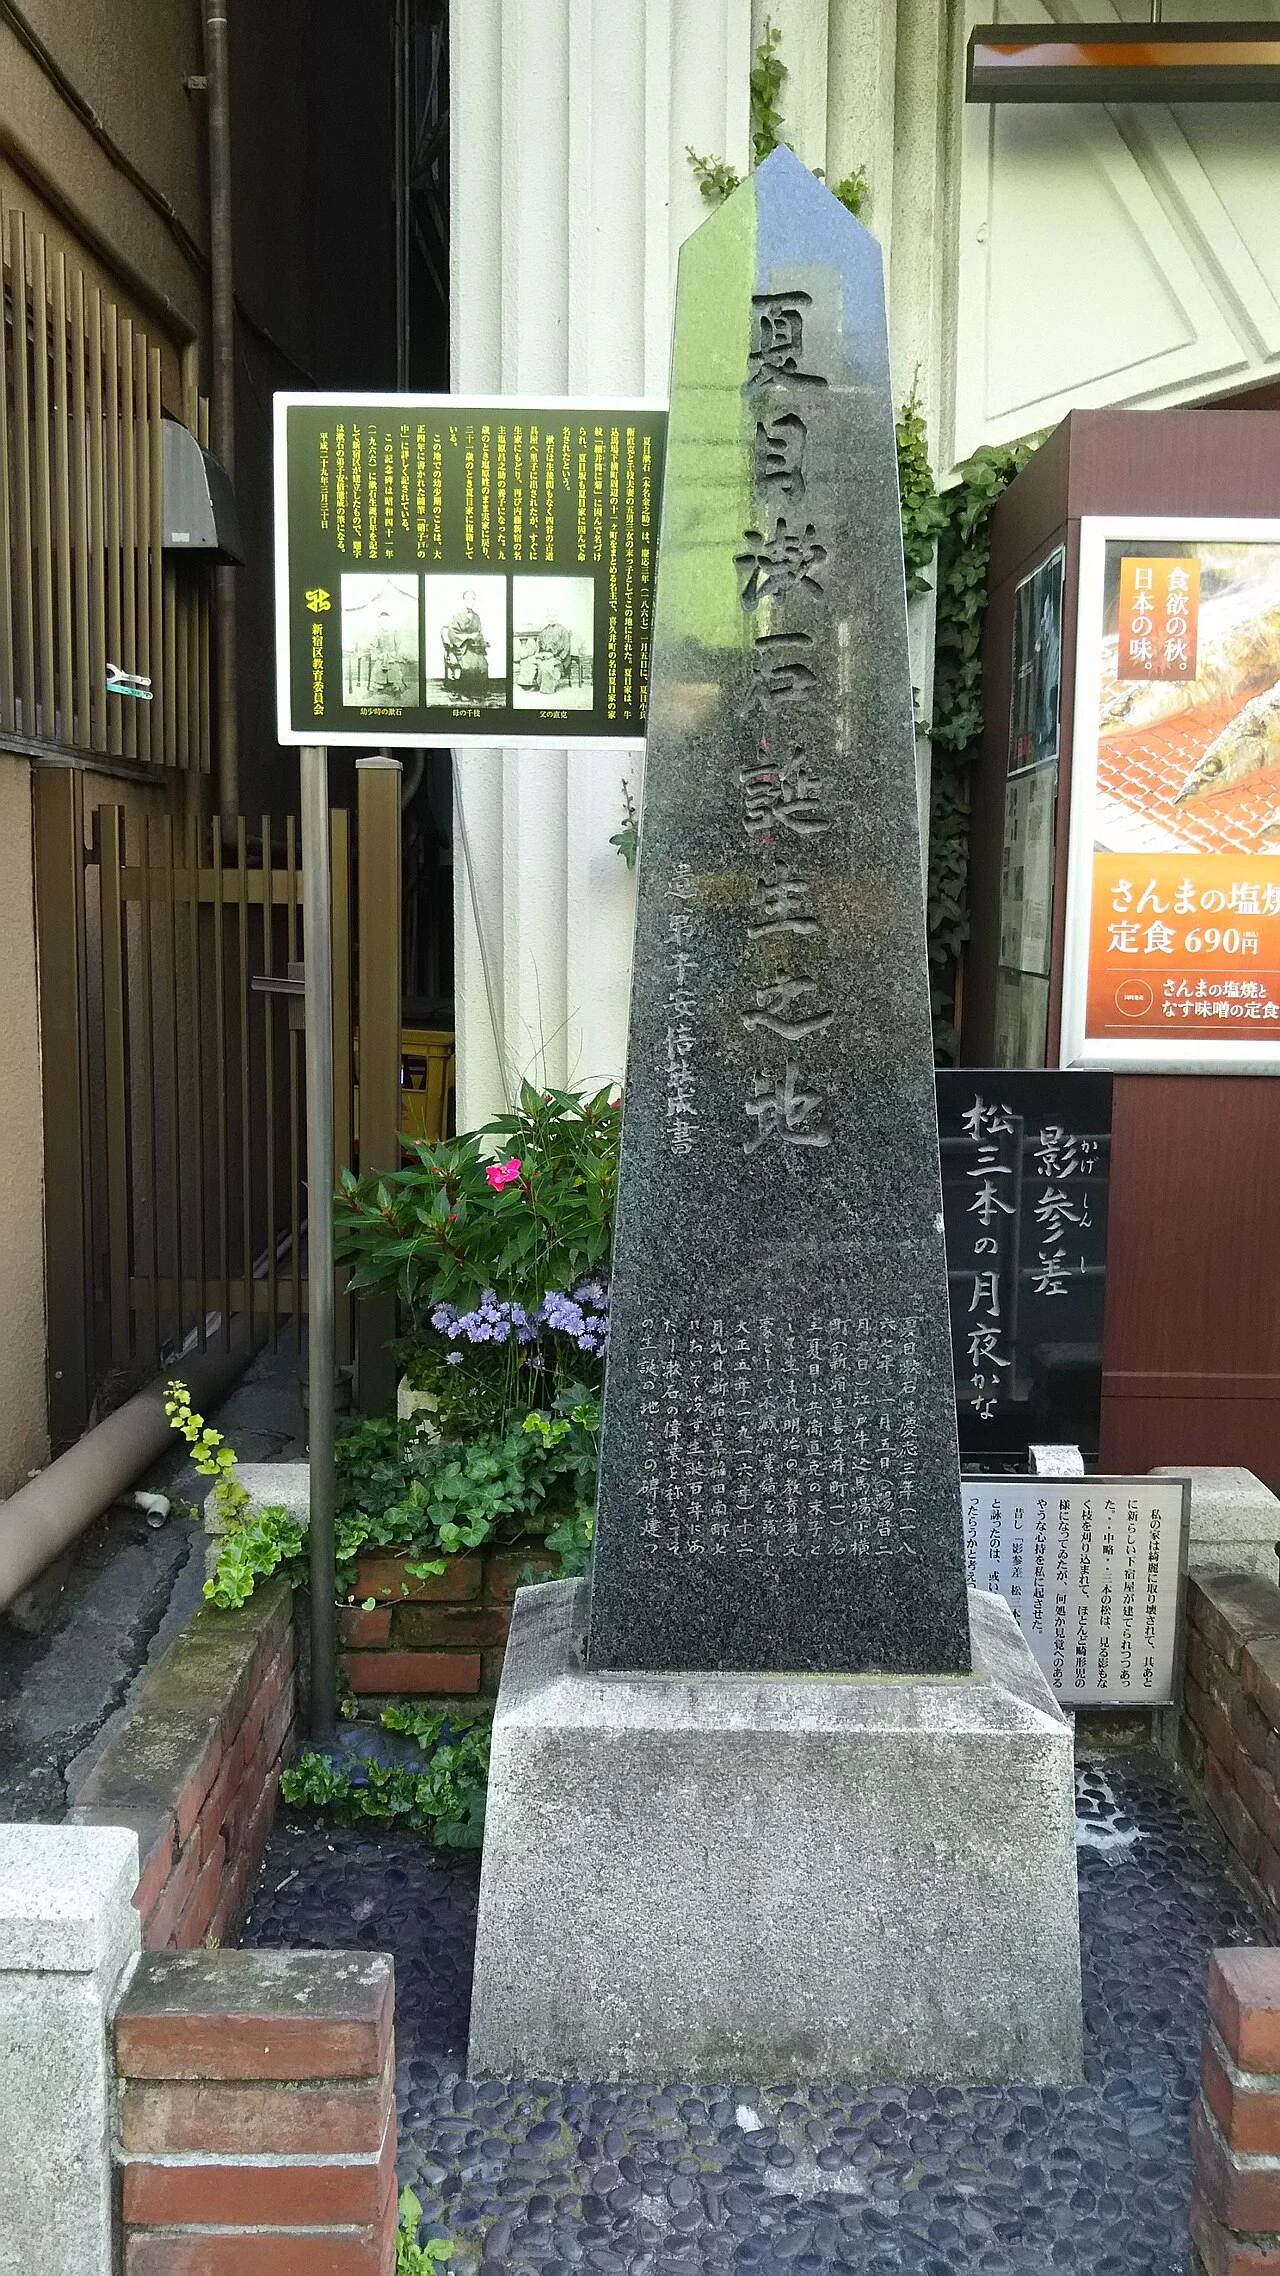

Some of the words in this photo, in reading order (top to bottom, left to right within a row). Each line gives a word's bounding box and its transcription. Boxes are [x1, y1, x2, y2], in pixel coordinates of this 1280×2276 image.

[448, 426, 458, 447] いる。
[384, 433, 394, 559] この記念碑は昭和四十一年
[311, 623, 324, 716] 新宿区教育委員会
[1128, 566, 1155, 670] 日本の味。
[1163, 566, 1191, 671] 食欲の秋。
[732, 289, 834, 1154] 夏目漱石誕生之地
[1106, 920, 1176, 955] 定食
[1184, 927, 1259, 955] 690円
[1162, 978, 1268, 998] さんまの塩焼と
[1080, 1139, 1099, 1175] かげ
[961, 1093, 1017, 1420] 松三本の月夜かな
[1031, 1125, 1080, 1296] 影参差
[1079, 1191, 1092, 1228] しん
[988, 1498, 1002, 1594] と詠ったのは、或い
[1031, 1499, 1048, 1634] やうな心持を私に起させた。
[1119, 1499, 1139, 1688] に新らしい下宿屋が建てられつつあっ
[1142, 1508, 1162, 1688] 私の家は綺麗に取り壊されて、其あと
